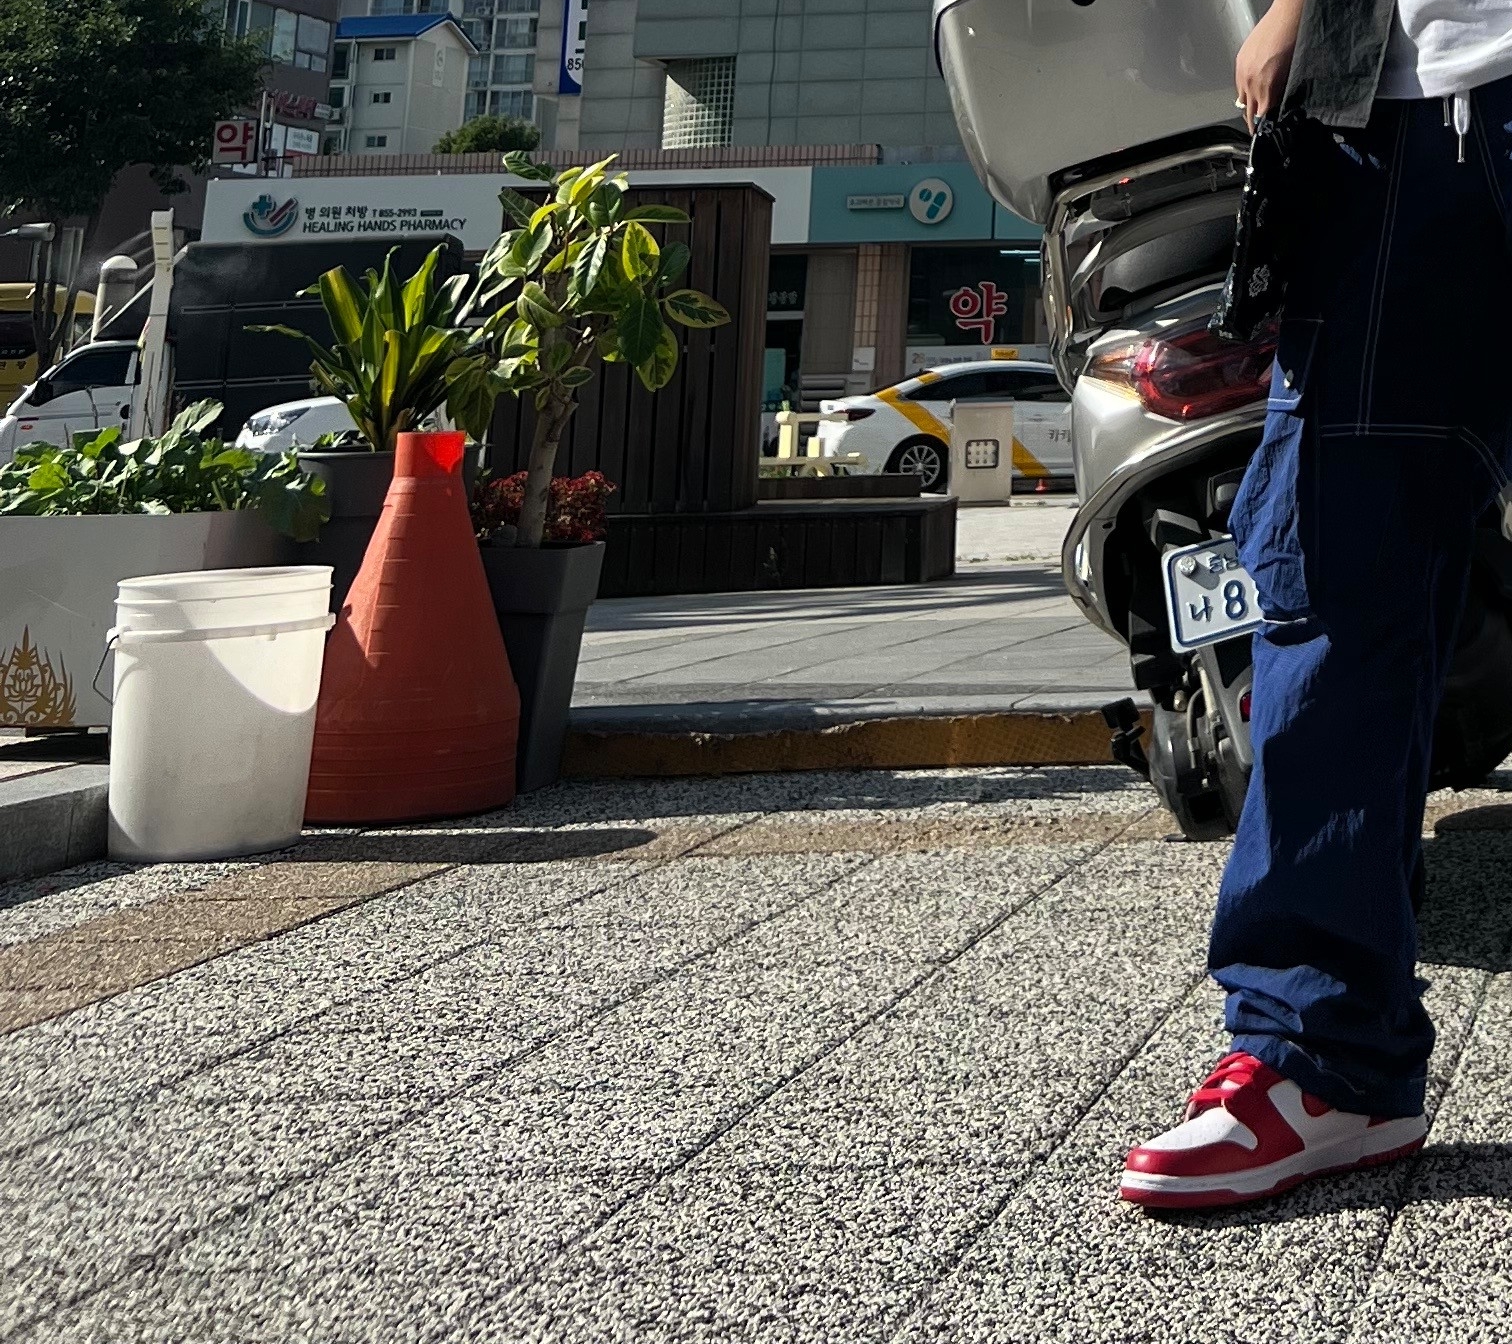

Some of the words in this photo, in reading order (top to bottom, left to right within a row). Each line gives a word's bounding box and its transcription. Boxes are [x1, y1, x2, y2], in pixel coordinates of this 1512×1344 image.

[216, 121, 255, 160] 약
[302, 220, 355, 233] HEALING
[357, 219, 397, 232] HANDS
[399, 218, 467, 231] PHARMACY
[950, 281, 1008, 345] 약
